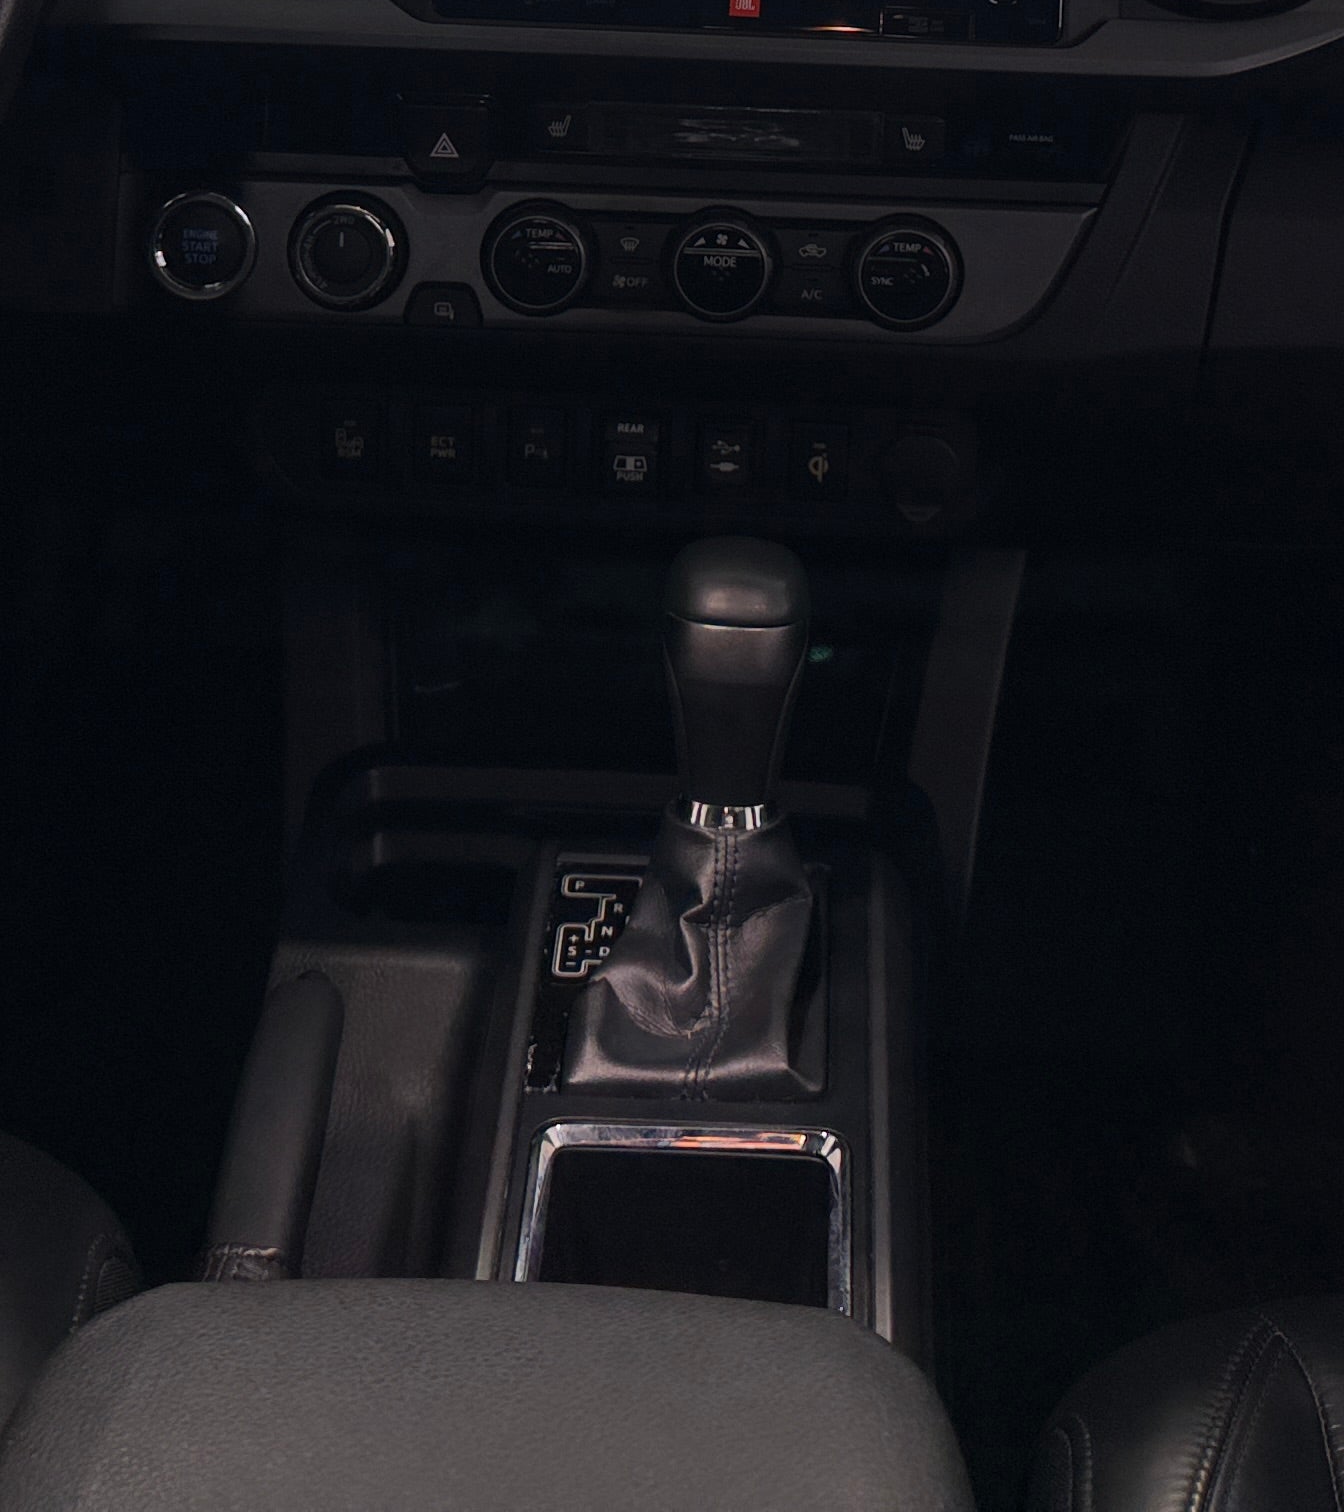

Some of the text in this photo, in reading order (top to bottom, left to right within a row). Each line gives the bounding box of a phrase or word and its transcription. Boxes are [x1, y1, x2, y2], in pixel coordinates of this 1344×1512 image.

[183, 229, 218, 240] ENGINE
[525, 228, 554, 239] TEMP
[181, 240, 218, 252] START
[892, 241, 923, 253] TEMP
[183, 252, 217, 265] STOP
[703, 256, 737, 268] MODE
[547, 264, 573, 274] AUTO
[626, 277, 649, 288] OFF
[871, 275, 895, 286] SYNC
[800, 288, 824, 300] A/C
[616, 422, 645, 434] REAR
[429, 435, 456, 447] ECT
[429, 447, 458, 458] PWR
[615, 471, 644, 482] PUSH
[574, 879, 586, 891] P
[613, 902, 625, 914] R
[600, 925, 615, 938] N
[567, 945, 578, 958] S
[598, 946, 611, 958] D
